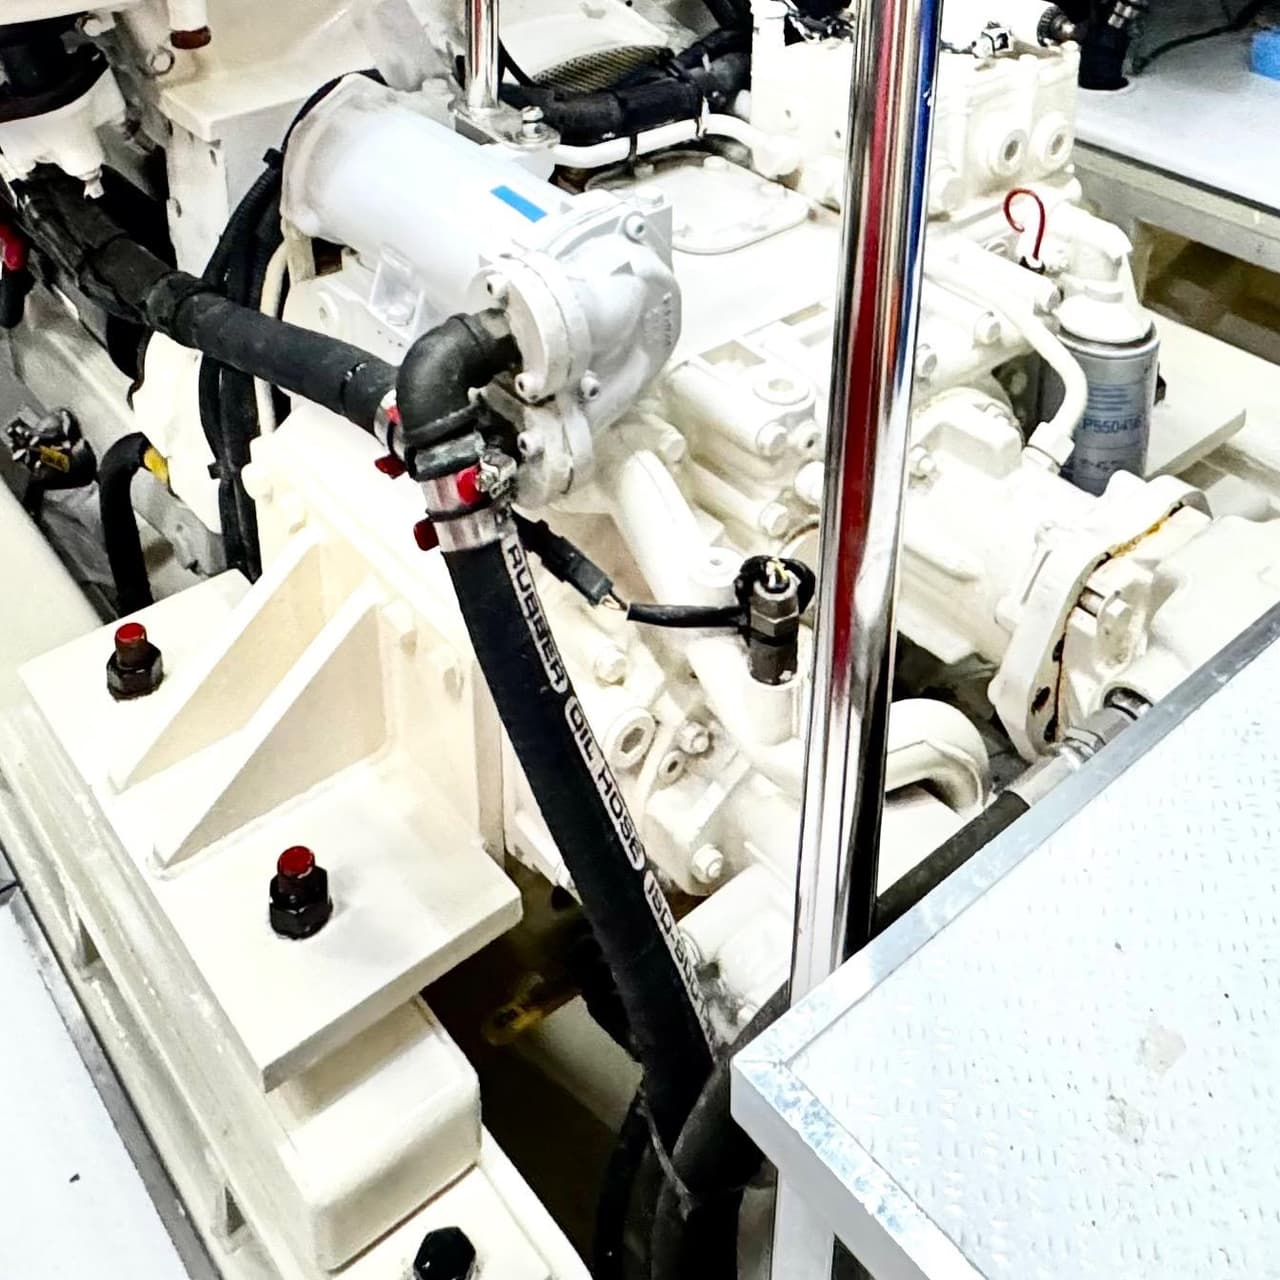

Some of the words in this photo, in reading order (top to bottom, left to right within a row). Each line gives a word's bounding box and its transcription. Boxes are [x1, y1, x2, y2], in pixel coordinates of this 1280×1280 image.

[507, 546, 566, 688] RUBBER
[568, 702, 596, 760] OIL
[596, 767, 642, 867] HOSE
